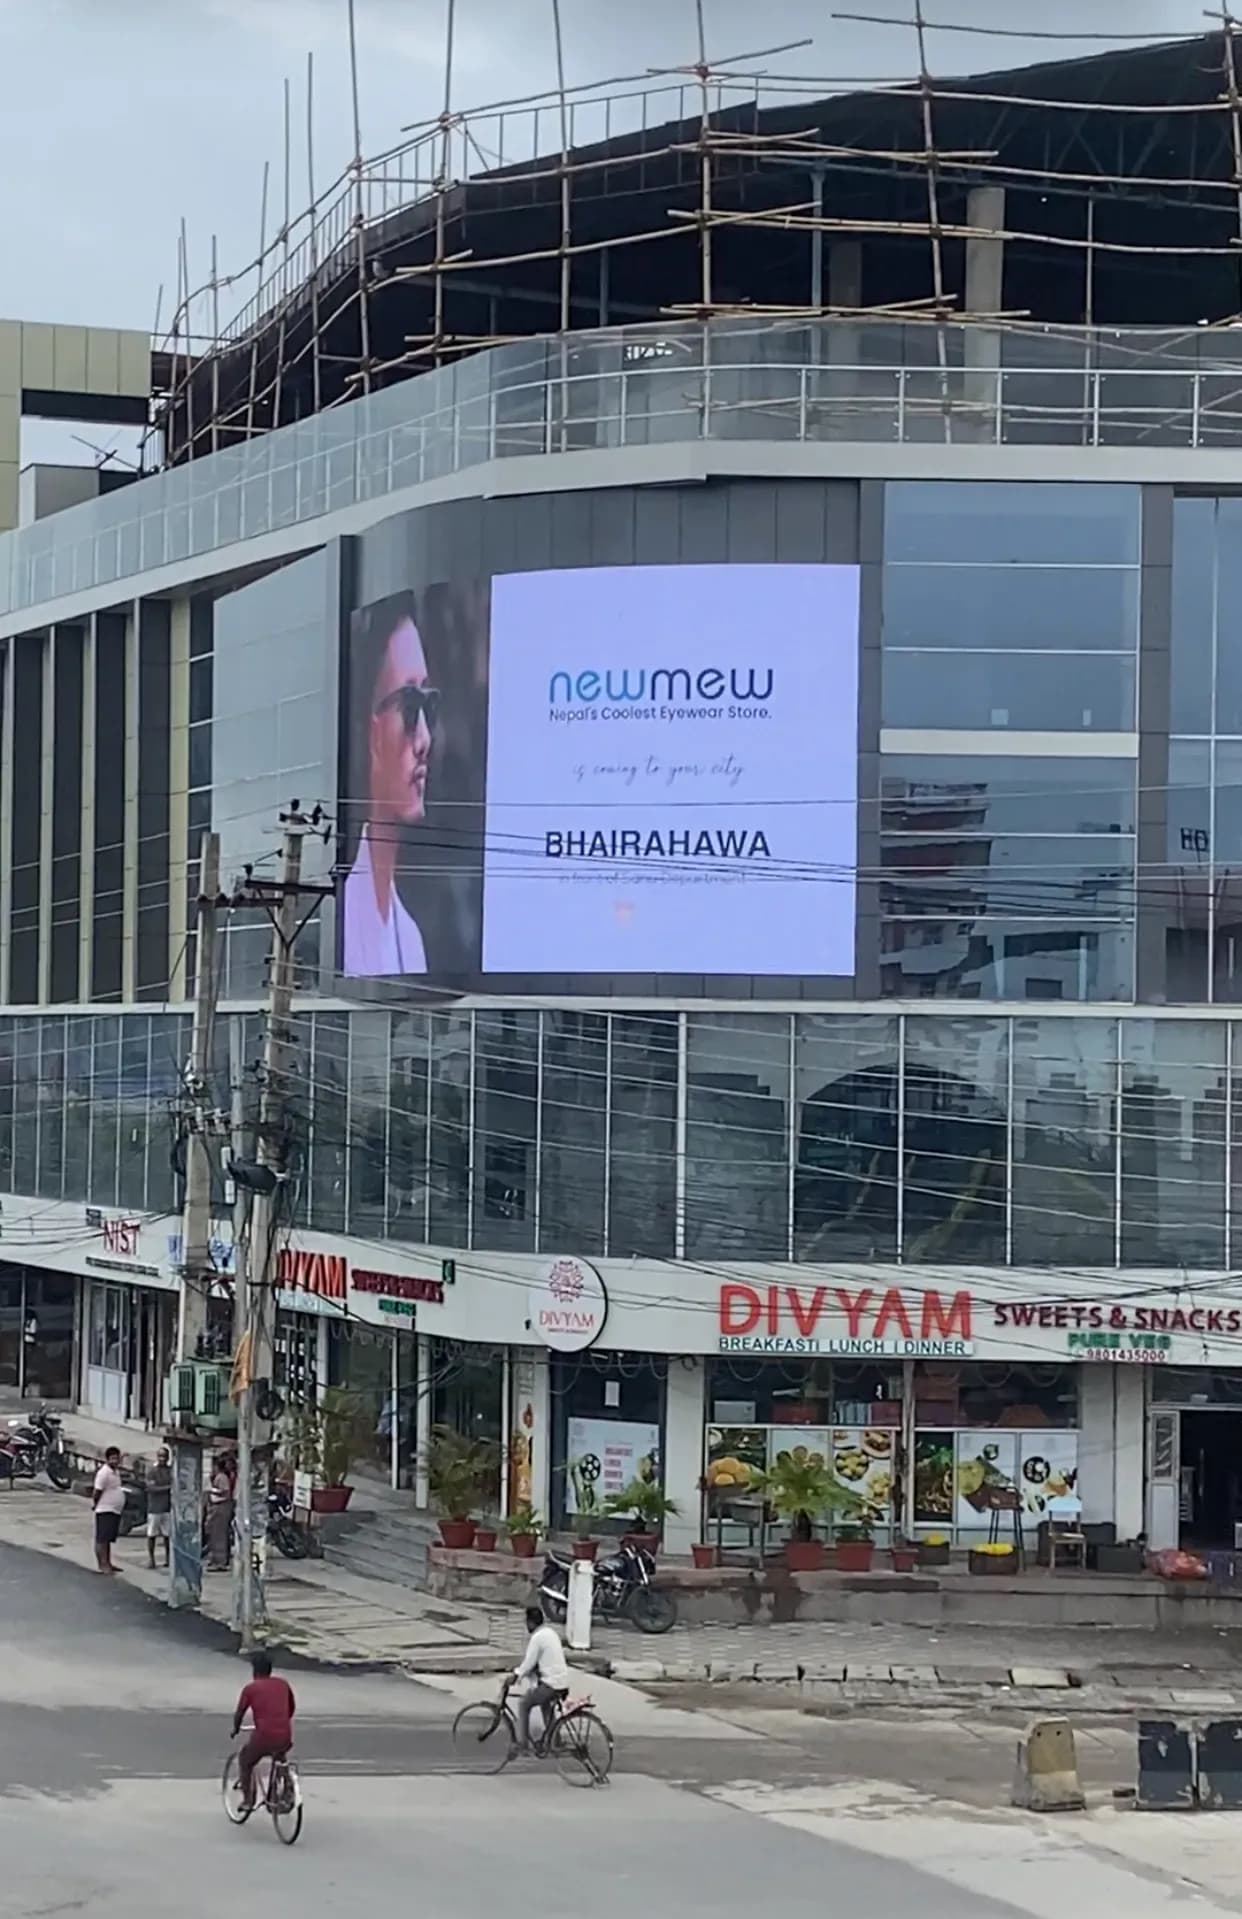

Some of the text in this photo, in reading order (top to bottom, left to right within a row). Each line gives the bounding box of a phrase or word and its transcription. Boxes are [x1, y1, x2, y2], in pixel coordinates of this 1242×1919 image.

[549, 667, 774, 703] newmew
[549, 705, 773, 726] Nepal's Coolest Eyewear Store.
[592, 763, 638, 787] coming
[645, 754, 660, 776] to
[666, 764, 702, 787] your
[710, 751, 744, 788] city
[545, 829, 771, 858] BHAIRAHAWA
[103, 1219, 141, 1257] NIST
[540, 1310, 595, 1328] DIVYAM
[719, 1284, 972, 1341] DIVYAM
[993, 1303, 1241, 1331] SWEETS & SNACKS
[829, 1339, 885, 1352] LUNCH
[903, 1340, 966, 1354] DINNER
[1067, 1332, 1172, 1350] PURE VEG
